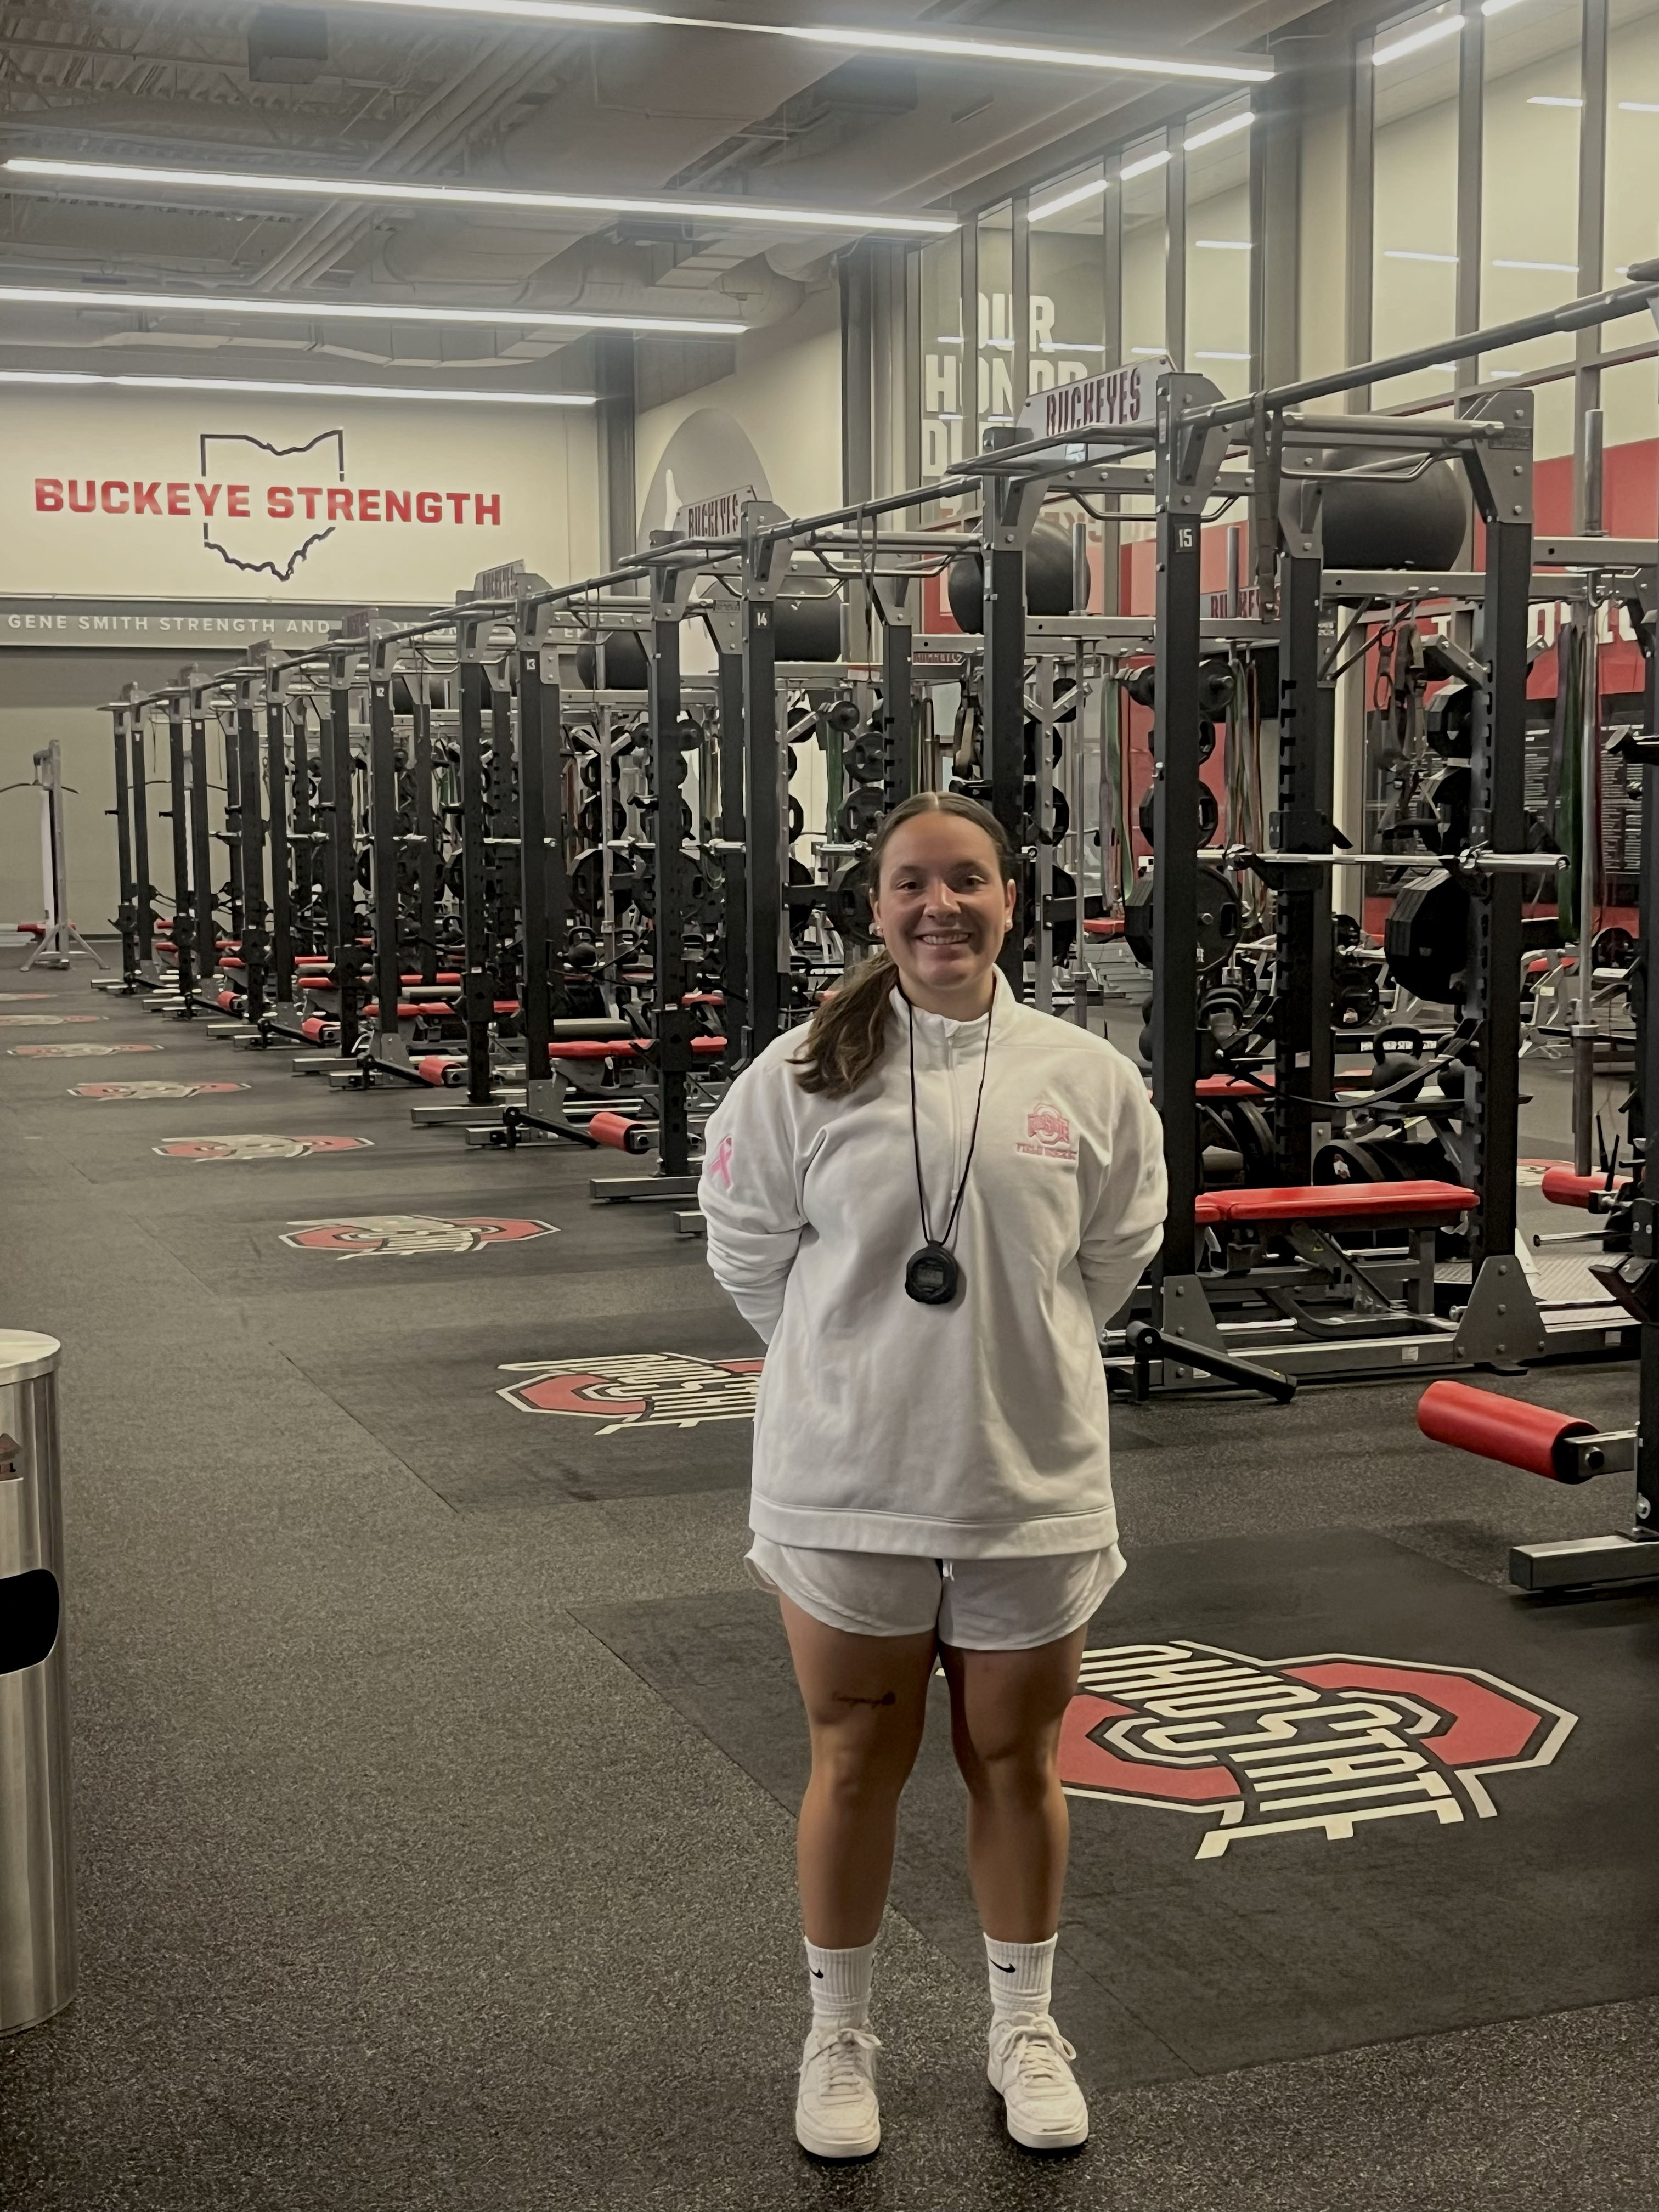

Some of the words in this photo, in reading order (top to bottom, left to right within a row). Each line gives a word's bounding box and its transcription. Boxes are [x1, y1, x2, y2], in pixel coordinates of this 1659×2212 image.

[35, 478, 250, 517] BUCKEYE
[267, 486, 500, 525] STRENGTH
[1179, 528, 1193, 548] 15
[8, 614, 67, 629] GENE
[78, 616, 148, 630] SMITH
[160, 617, 275, 632] STRENGTH
[286, 620, 330, 633] AND
[1142, 1702, 1464, 1860] STATE
